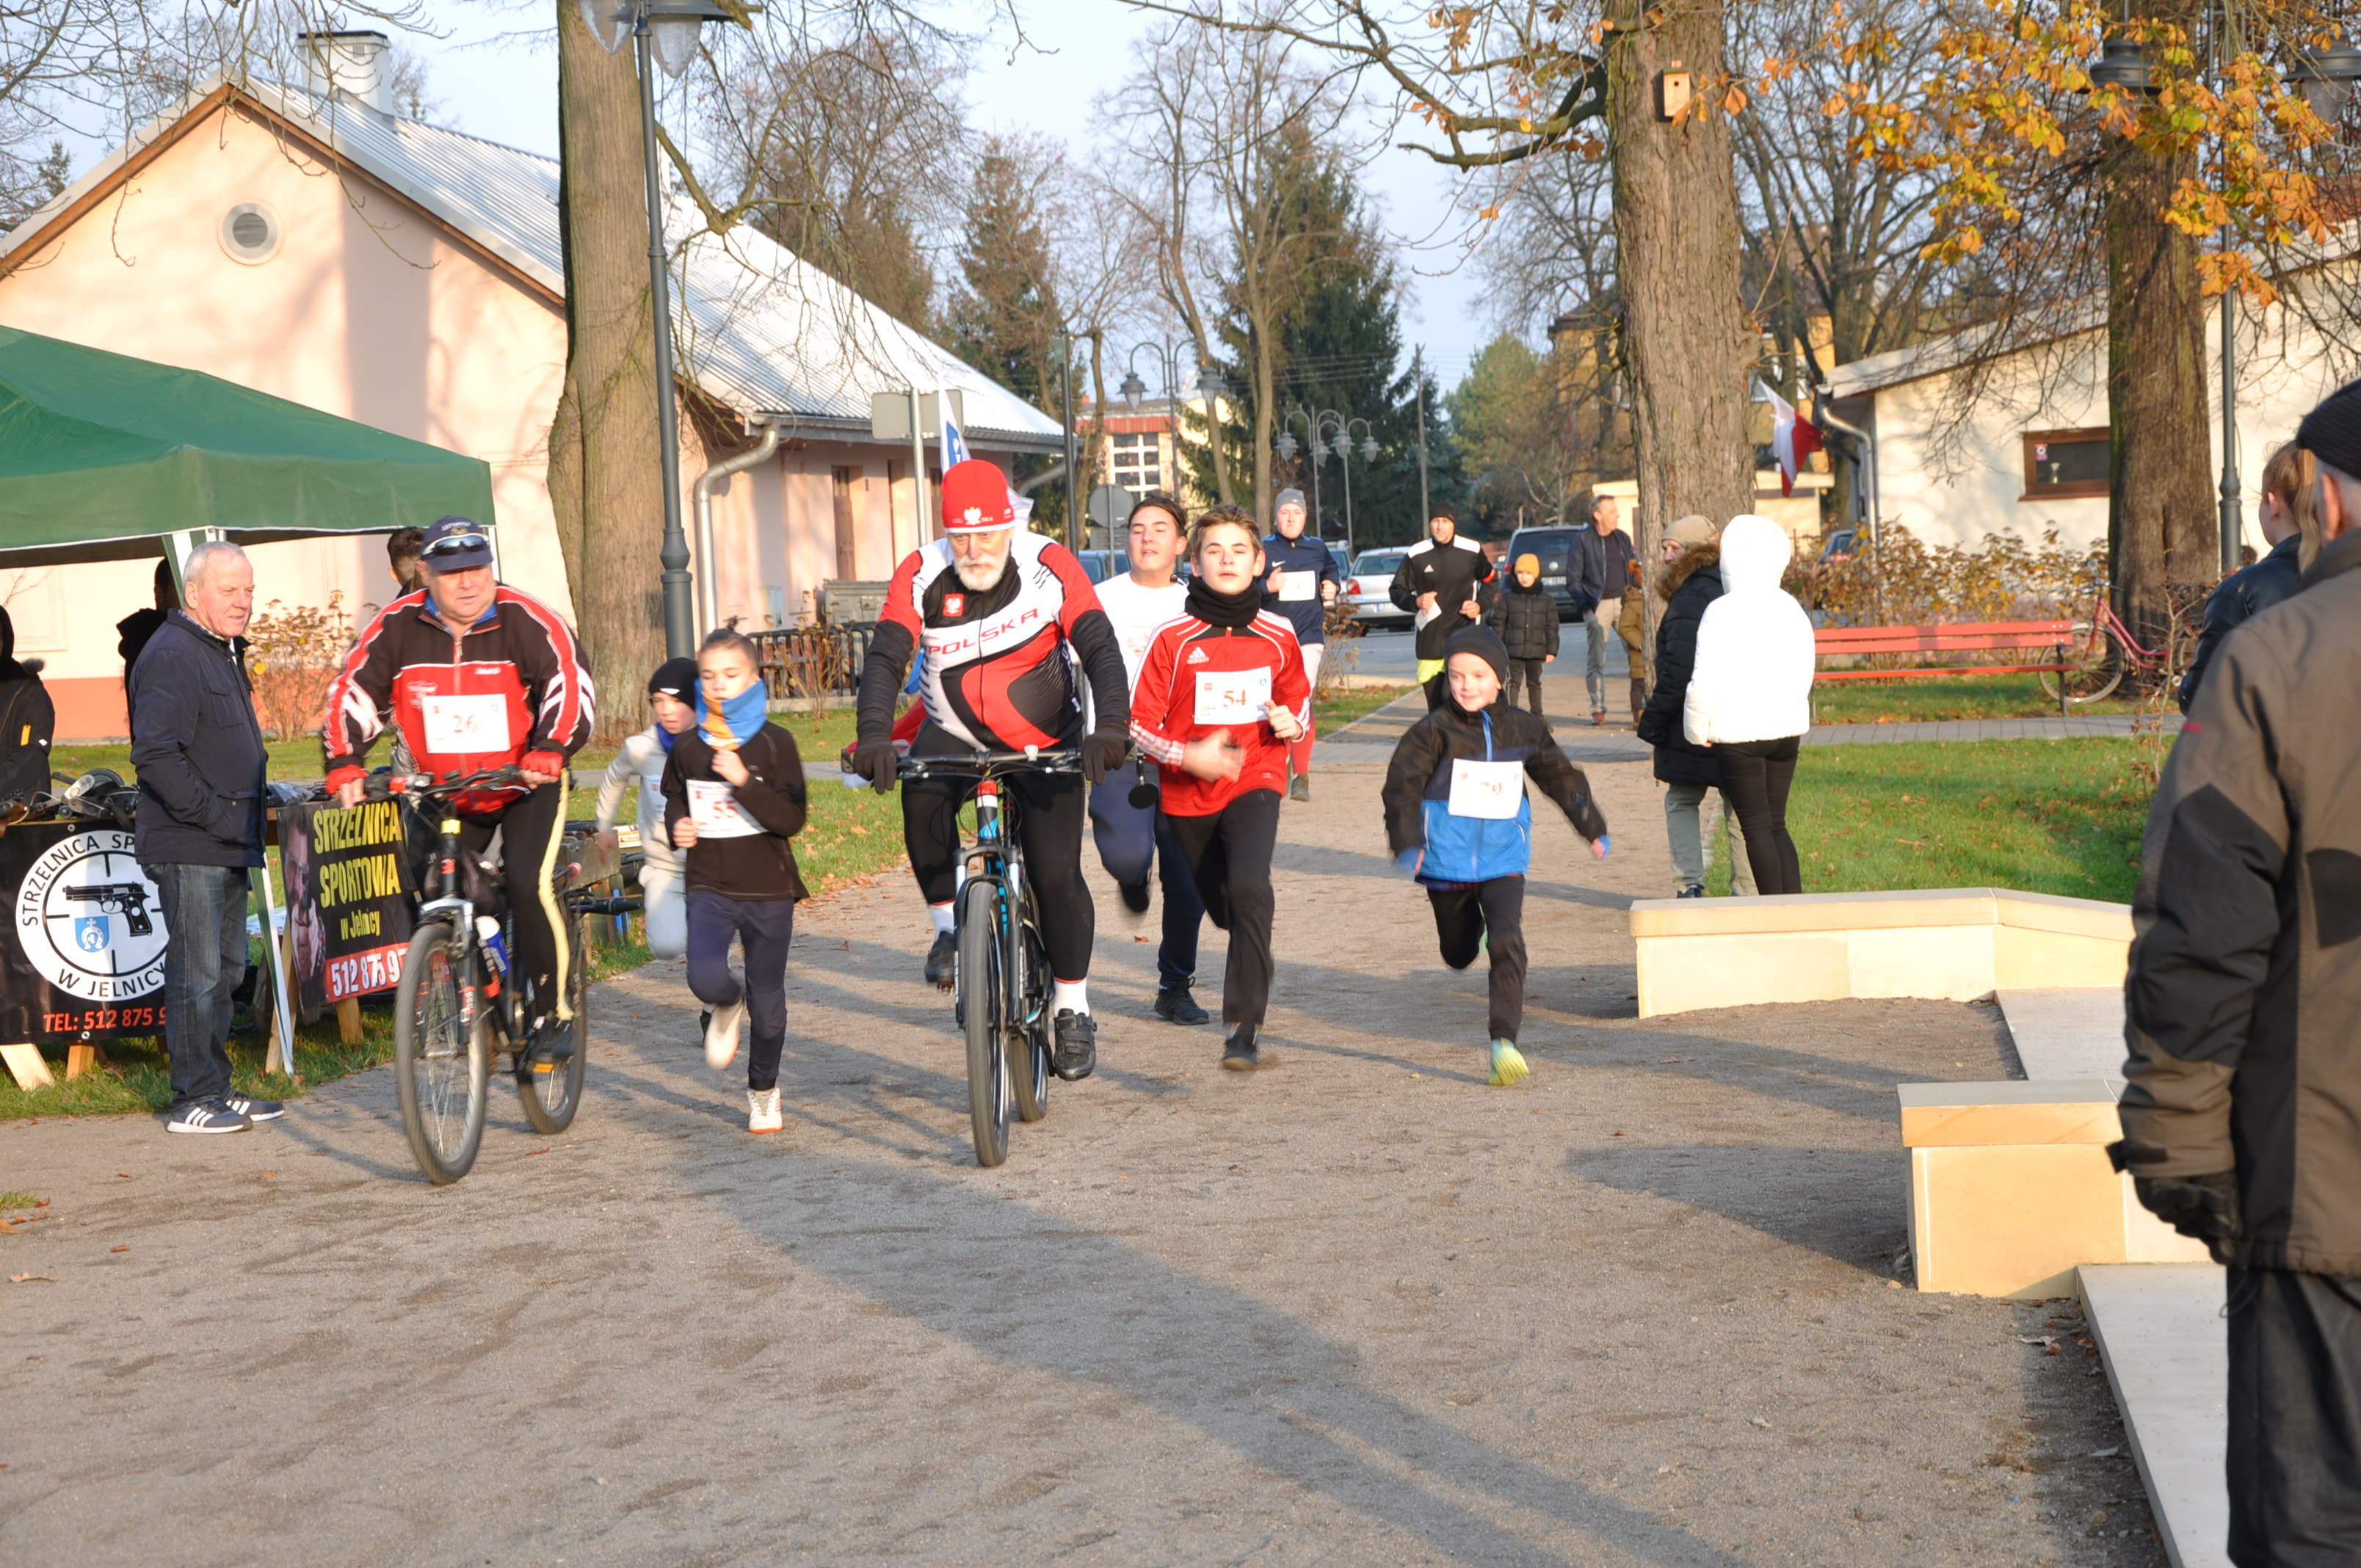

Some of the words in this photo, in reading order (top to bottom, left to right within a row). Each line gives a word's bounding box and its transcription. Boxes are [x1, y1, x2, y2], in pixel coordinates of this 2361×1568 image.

[928, 608, 1038, 655] POLSKA
[1222, 689, 1247, 708] 54
[452, 715, 479, 733] 26
[313, 801, 402, 854] STRZELNICA
[712, 800, 739, 819] 55
[22, 835, 101, 926] STRZELNICA
[319, 853, 402, 908] SPORTOWA
[58, 968, 81, 990] W
[87, 962, 166, 998] JELNICY
[331, 958, 359, 997] 512
[360, 954, 387, 990] 875
[43, 1012, 79, 1033] TEL:
[83, 1009, 117, 1031] 512
[121, 1007, 153, 1028] 875
